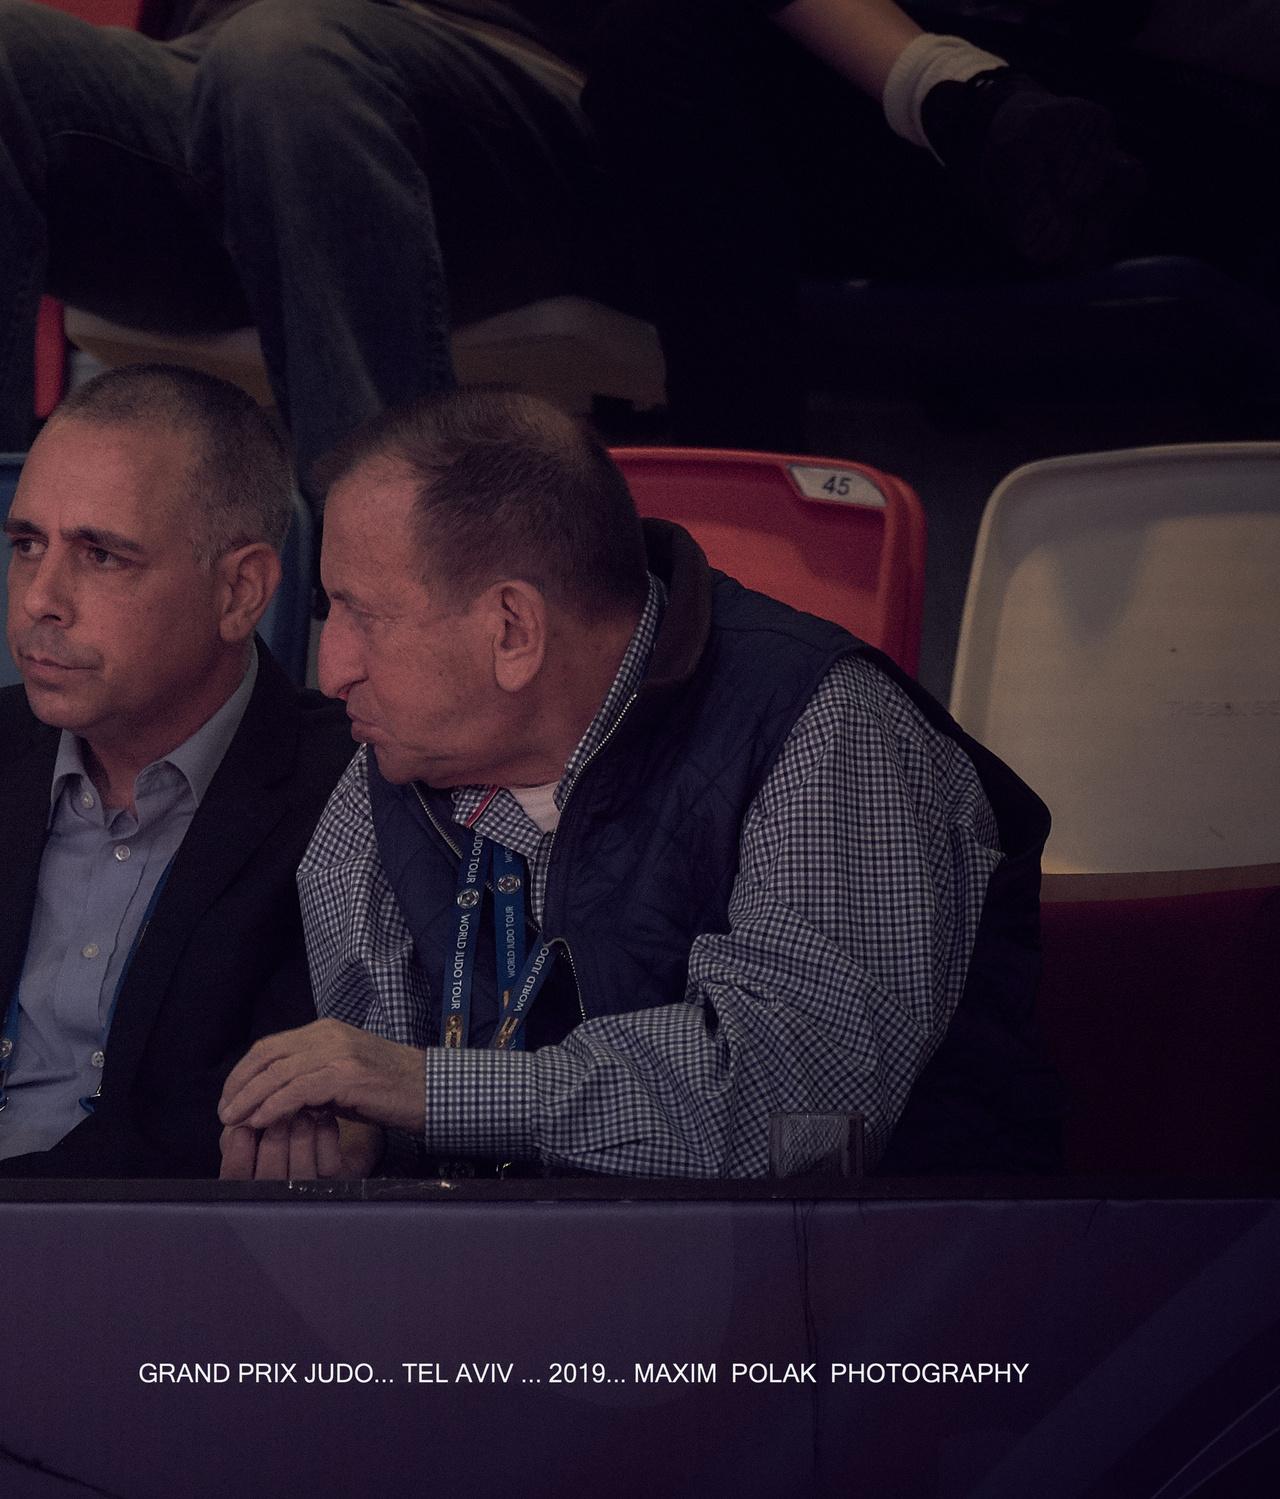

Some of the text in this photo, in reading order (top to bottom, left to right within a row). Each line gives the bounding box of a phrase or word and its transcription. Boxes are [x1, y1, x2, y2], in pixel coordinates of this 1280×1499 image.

[823, 476, 851, 496] 45
[466, 857, 481, 884] TOUR
[451, 913, 470, 1010] WORLD JUDO TOUR
[505, 905, 516, 978] WORLD JUDO TOUR
[513, 947, 549, 1012] WORLD JUDO
